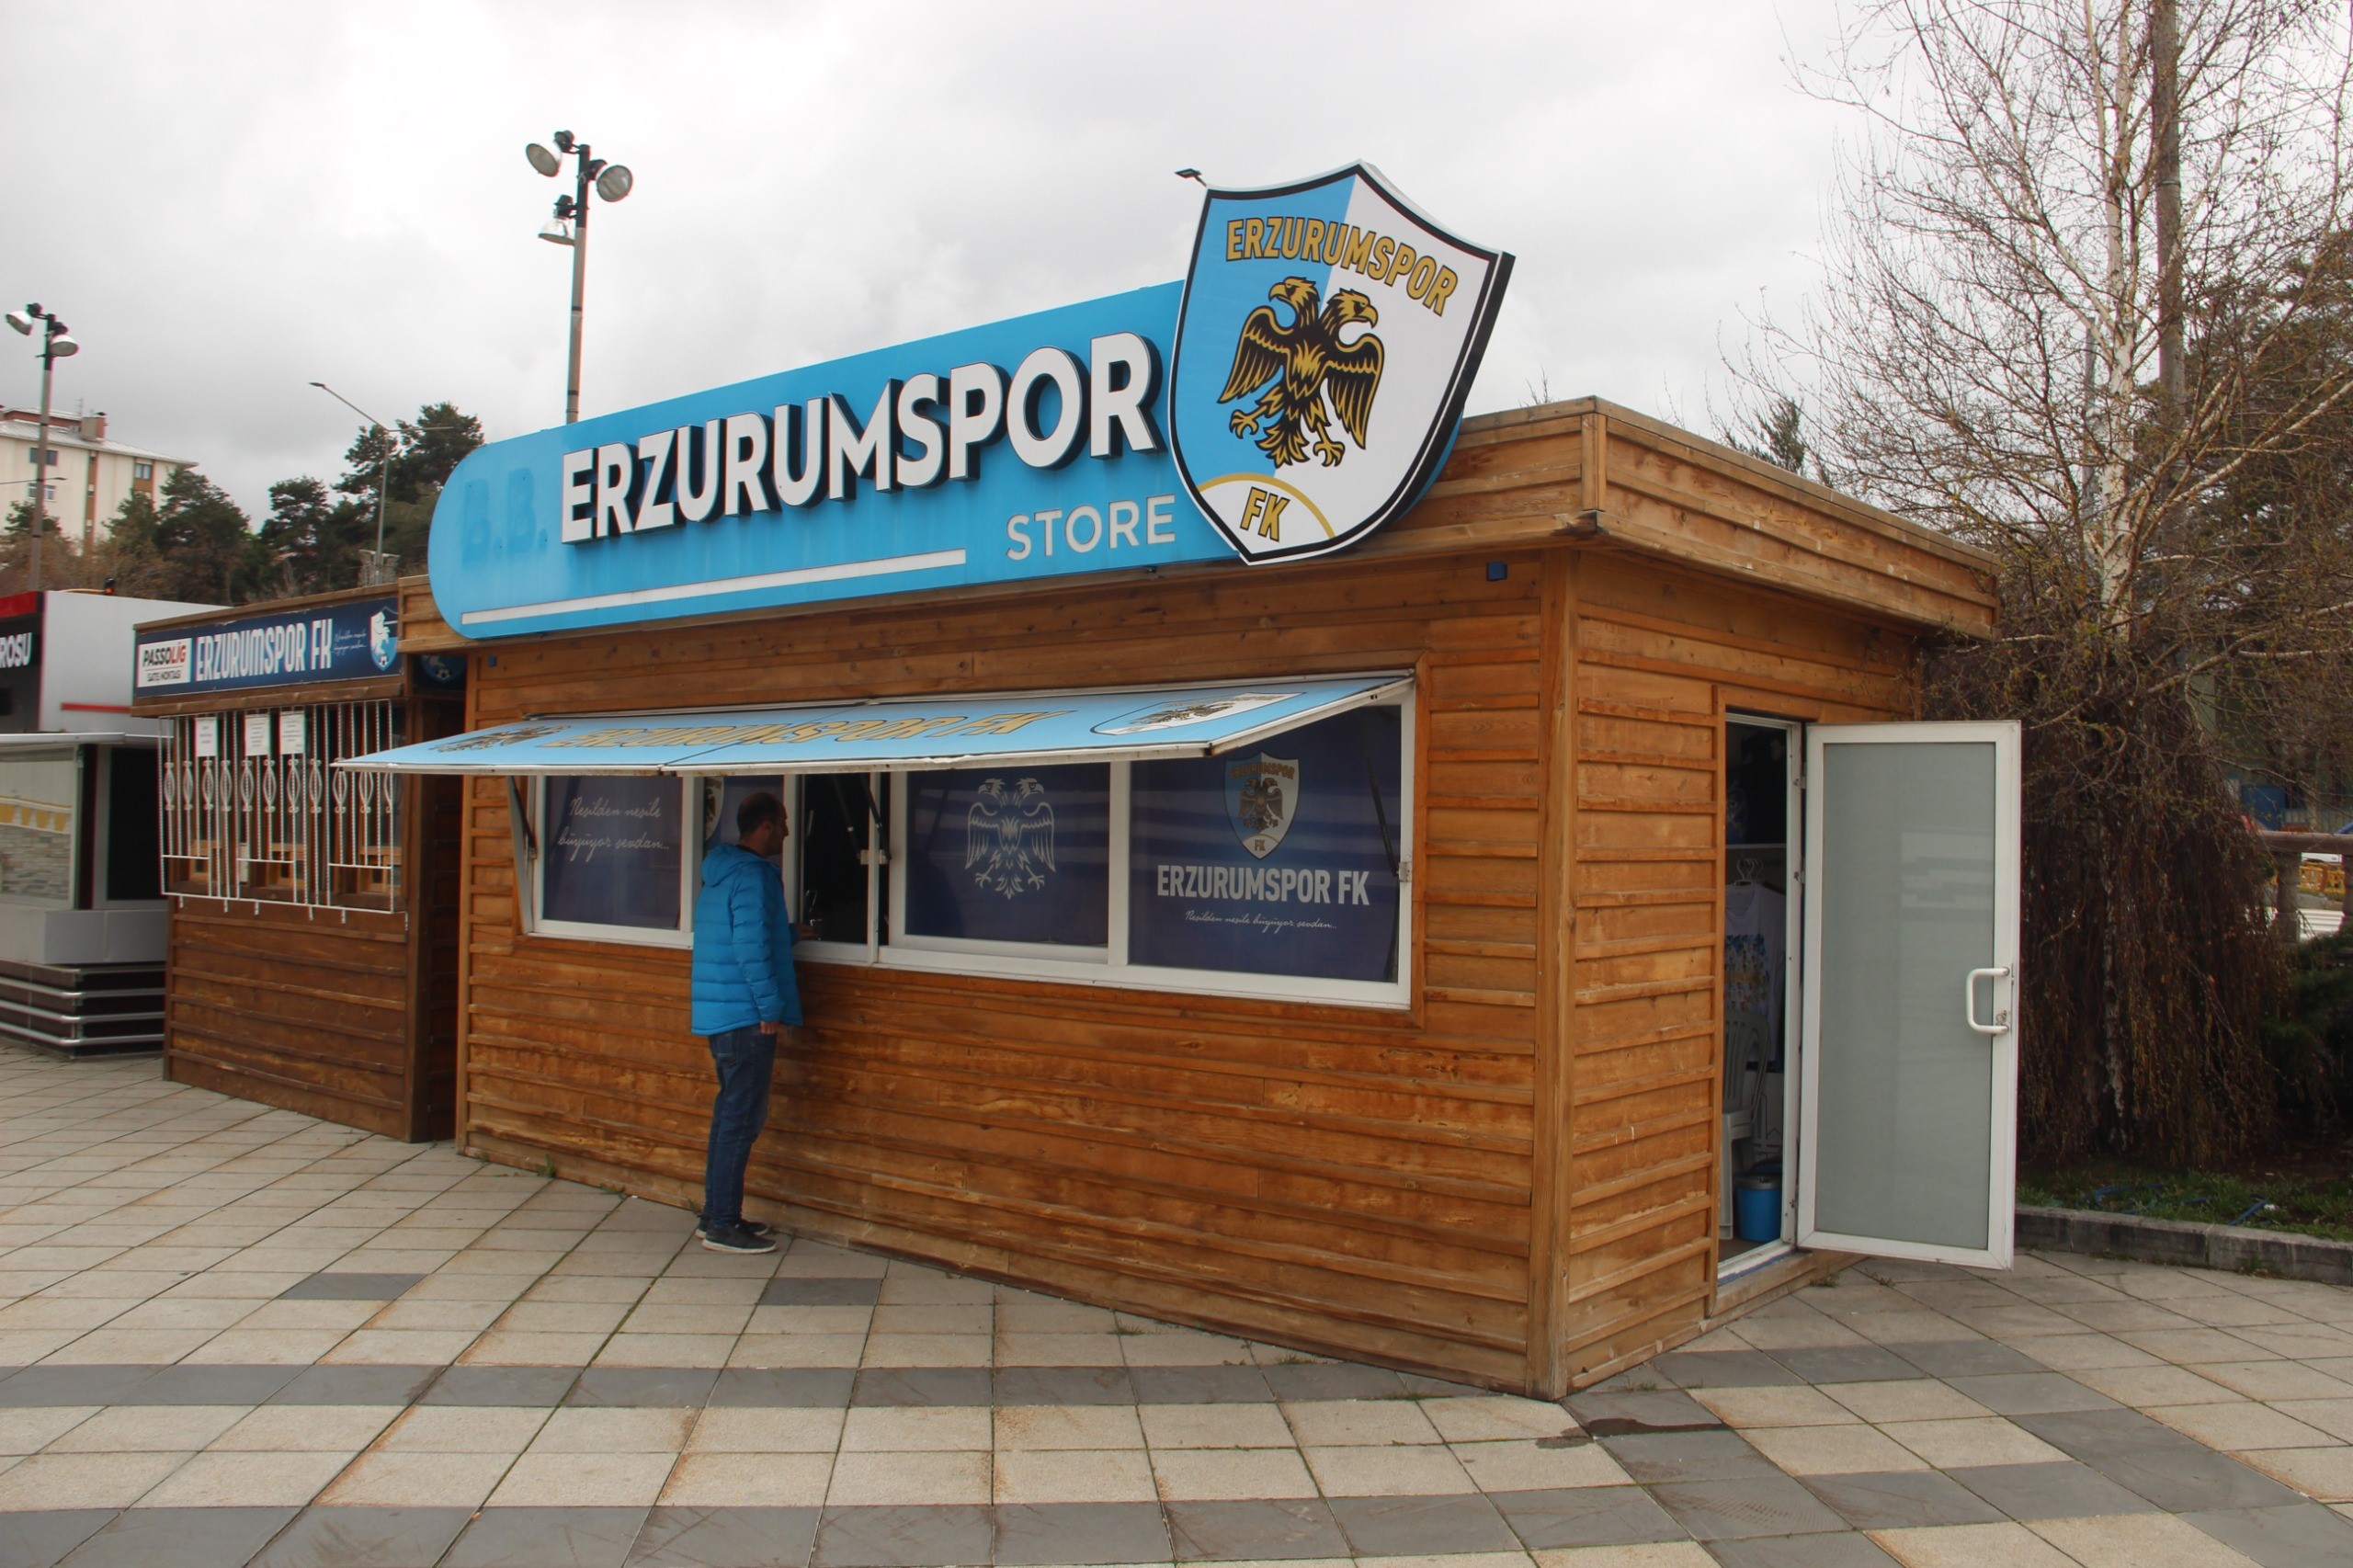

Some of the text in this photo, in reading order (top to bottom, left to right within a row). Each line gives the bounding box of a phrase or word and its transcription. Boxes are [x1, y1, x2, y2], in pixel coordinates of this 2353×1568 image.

[1225, 215, 1458, 317] ERZURUMSPOR
[562, 331, 1164, 544] ERZURUMSPOR
[1006, 493, 1176, 561] STORE
[1239, 486, 1290, 542] FK
[196, 618, 333, 682] ERZURUMSPOR FK
[1254, 839, 1266, 852] FK
[1157, 865, 1370, 906] ERZURUMSPOR FK
